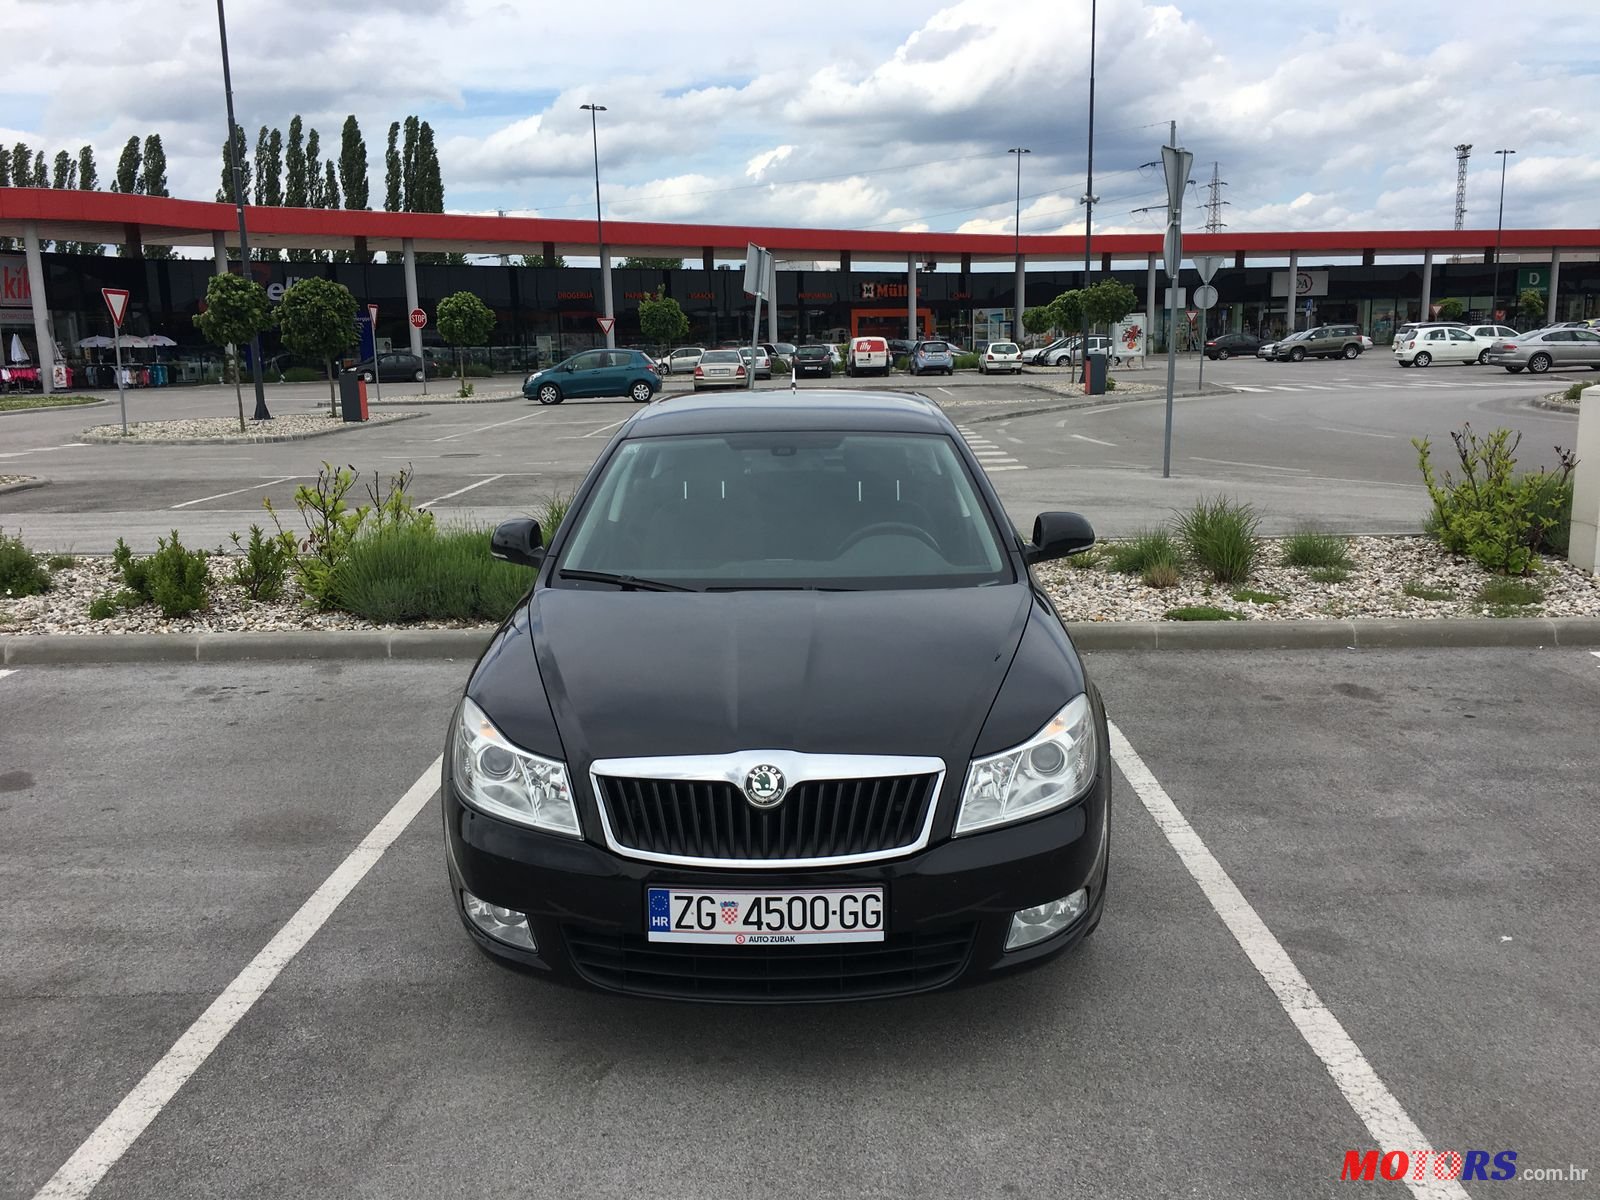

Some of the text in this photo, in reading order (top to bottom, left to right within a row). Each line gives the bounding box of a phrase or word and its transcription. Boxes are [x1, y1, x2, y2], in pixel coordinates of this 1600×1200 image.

[1529, 272, 1540, 285] D
[877, 284, 921, 297] Müllr
[411, 314, 425, 323] STOP
[860, 341, 872, 352] illy
[674, 895, 717, 931] ZG
[652, 916, 668, 926] HR
[749, 935, 796, 943] AUTO ZUBAK
